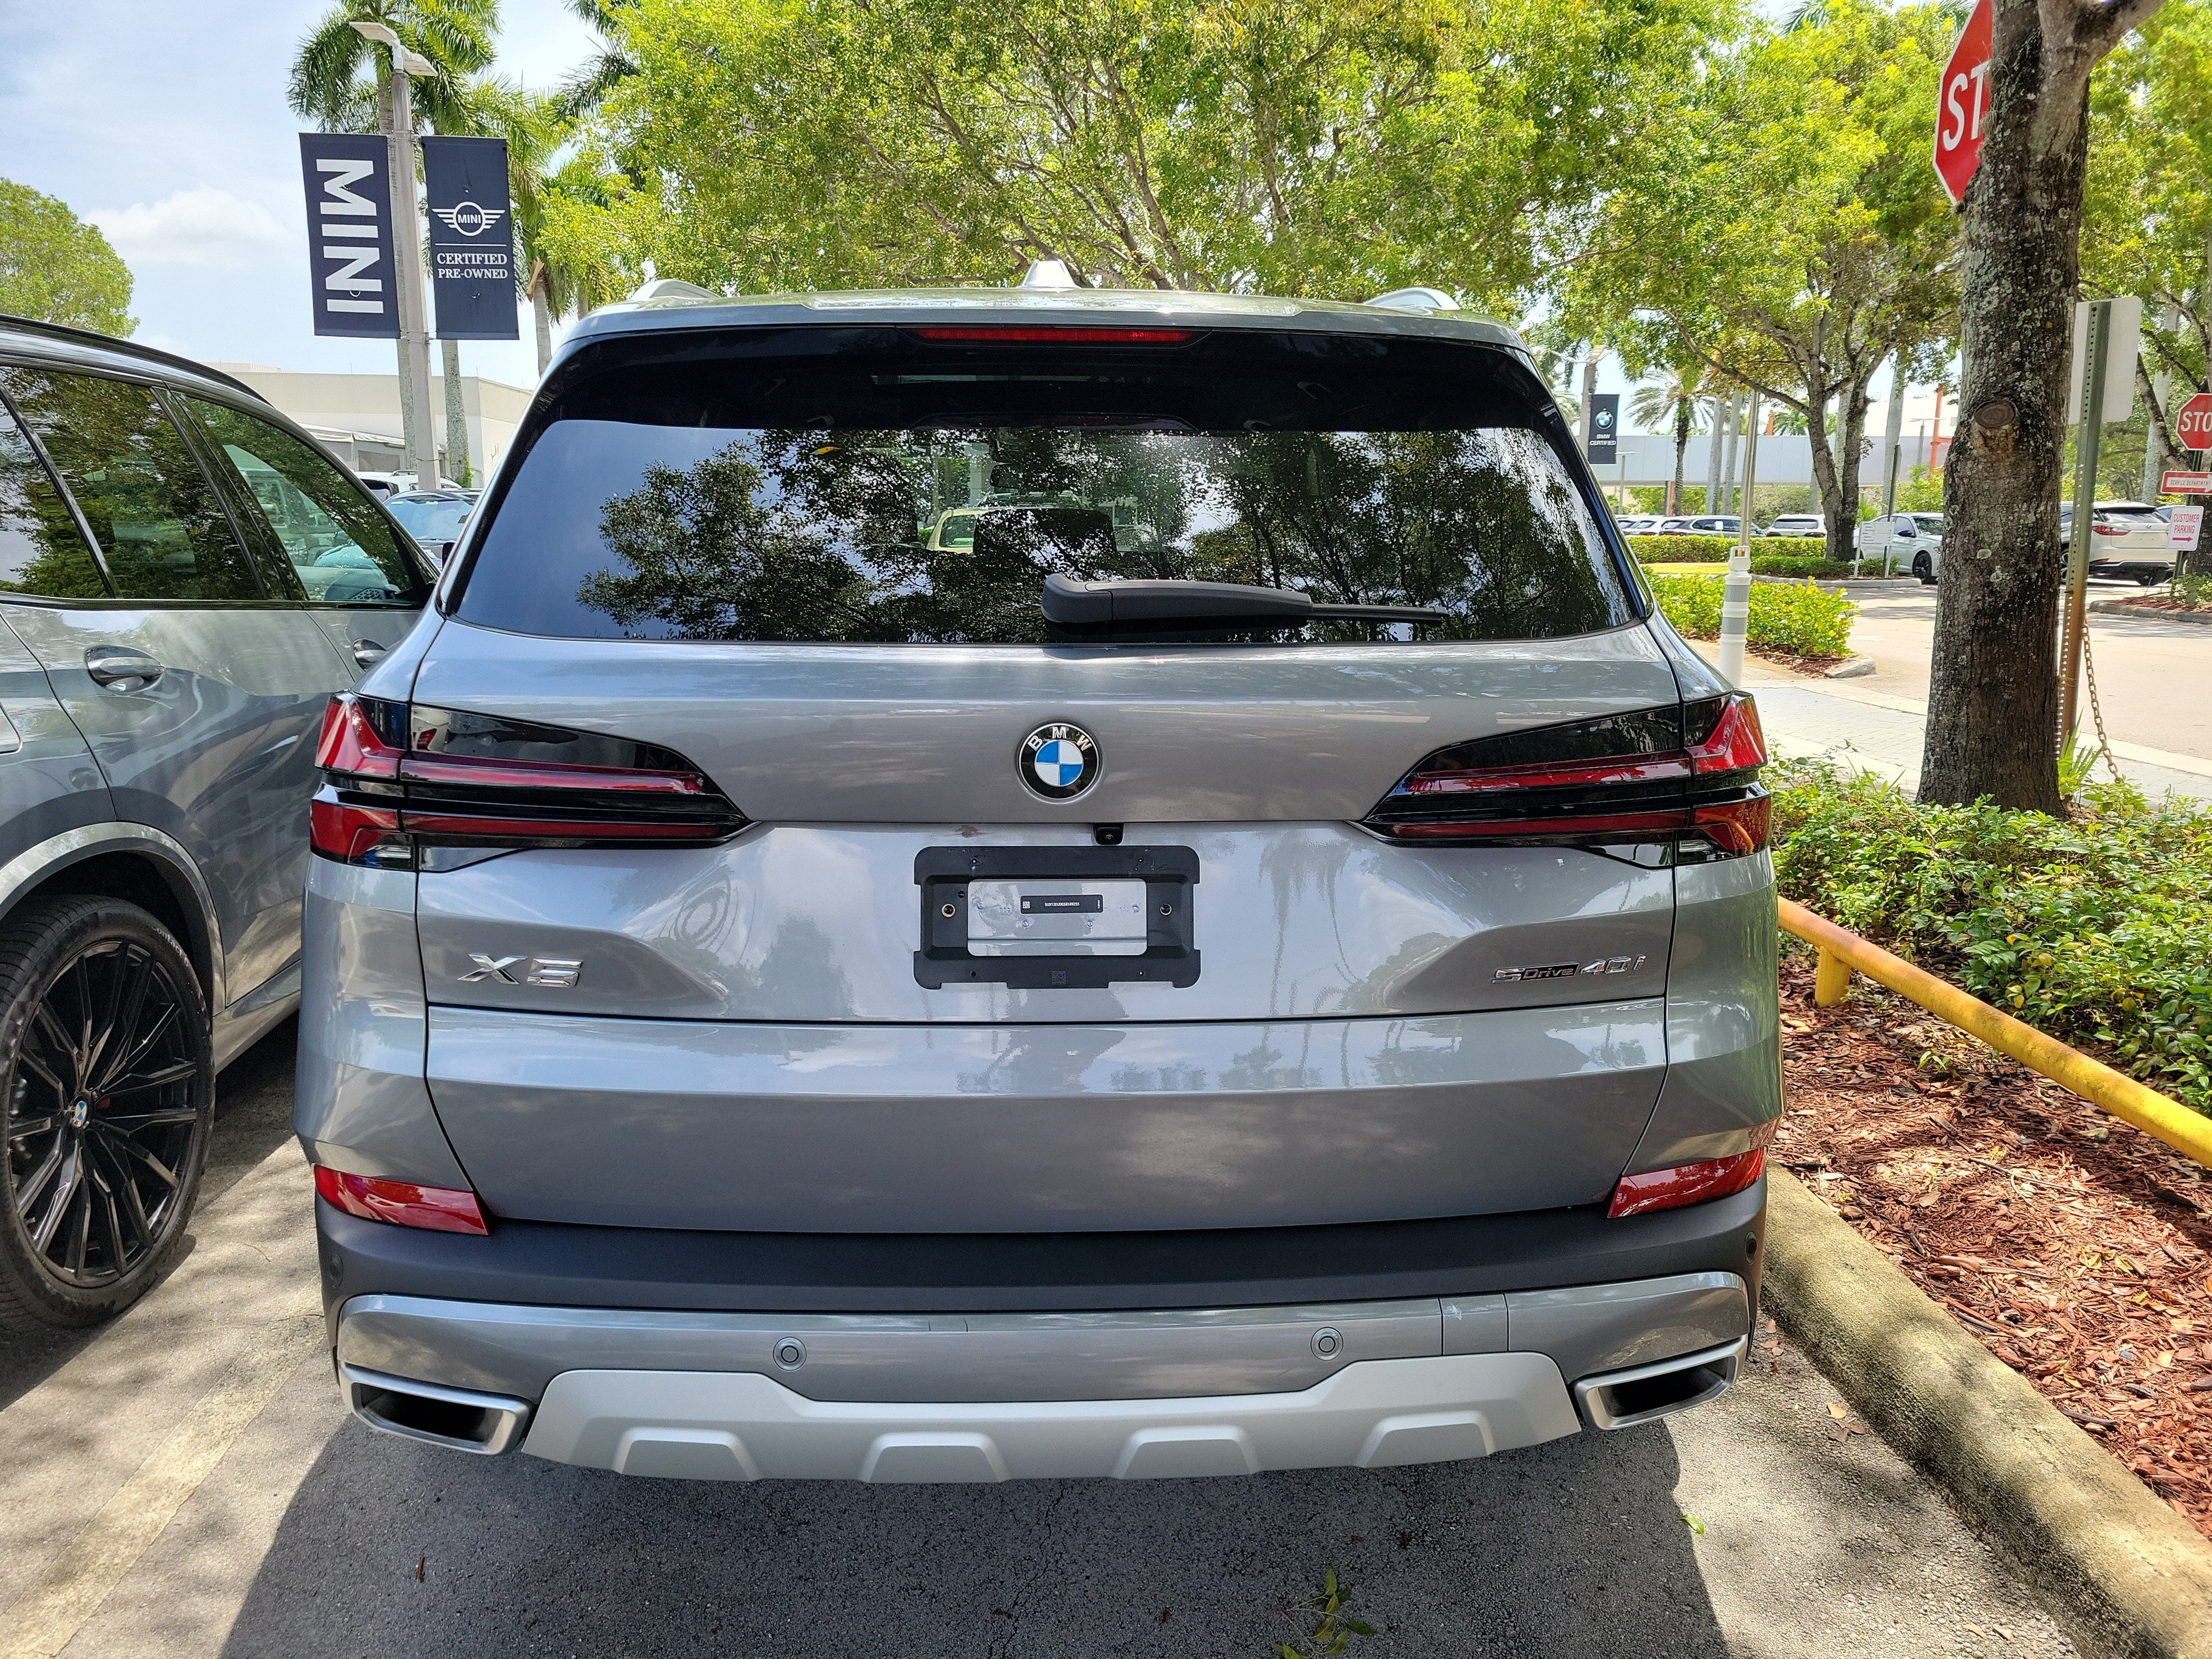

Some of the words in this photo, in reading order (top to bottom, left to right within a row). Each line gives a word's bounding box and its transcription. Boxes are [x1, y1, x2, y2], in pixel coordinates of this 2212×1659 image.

[1943, 59, 1992, 152] ST
[458, 214, 481, 224] MINI
[316, 159, 384, 314] MINI
[437, 253, 507, 264] CERTIFIED
[438, 268, 508, 279] PRE-OWNED
[2180, 411, 2212, 432] STO
[2174, 514, 2200, 522] CUSTOMER
[2174, 524, 2195, 533] PARKING
[1028, 726, 1092, 751] BMW
[457, 952, 583, 988] X5
